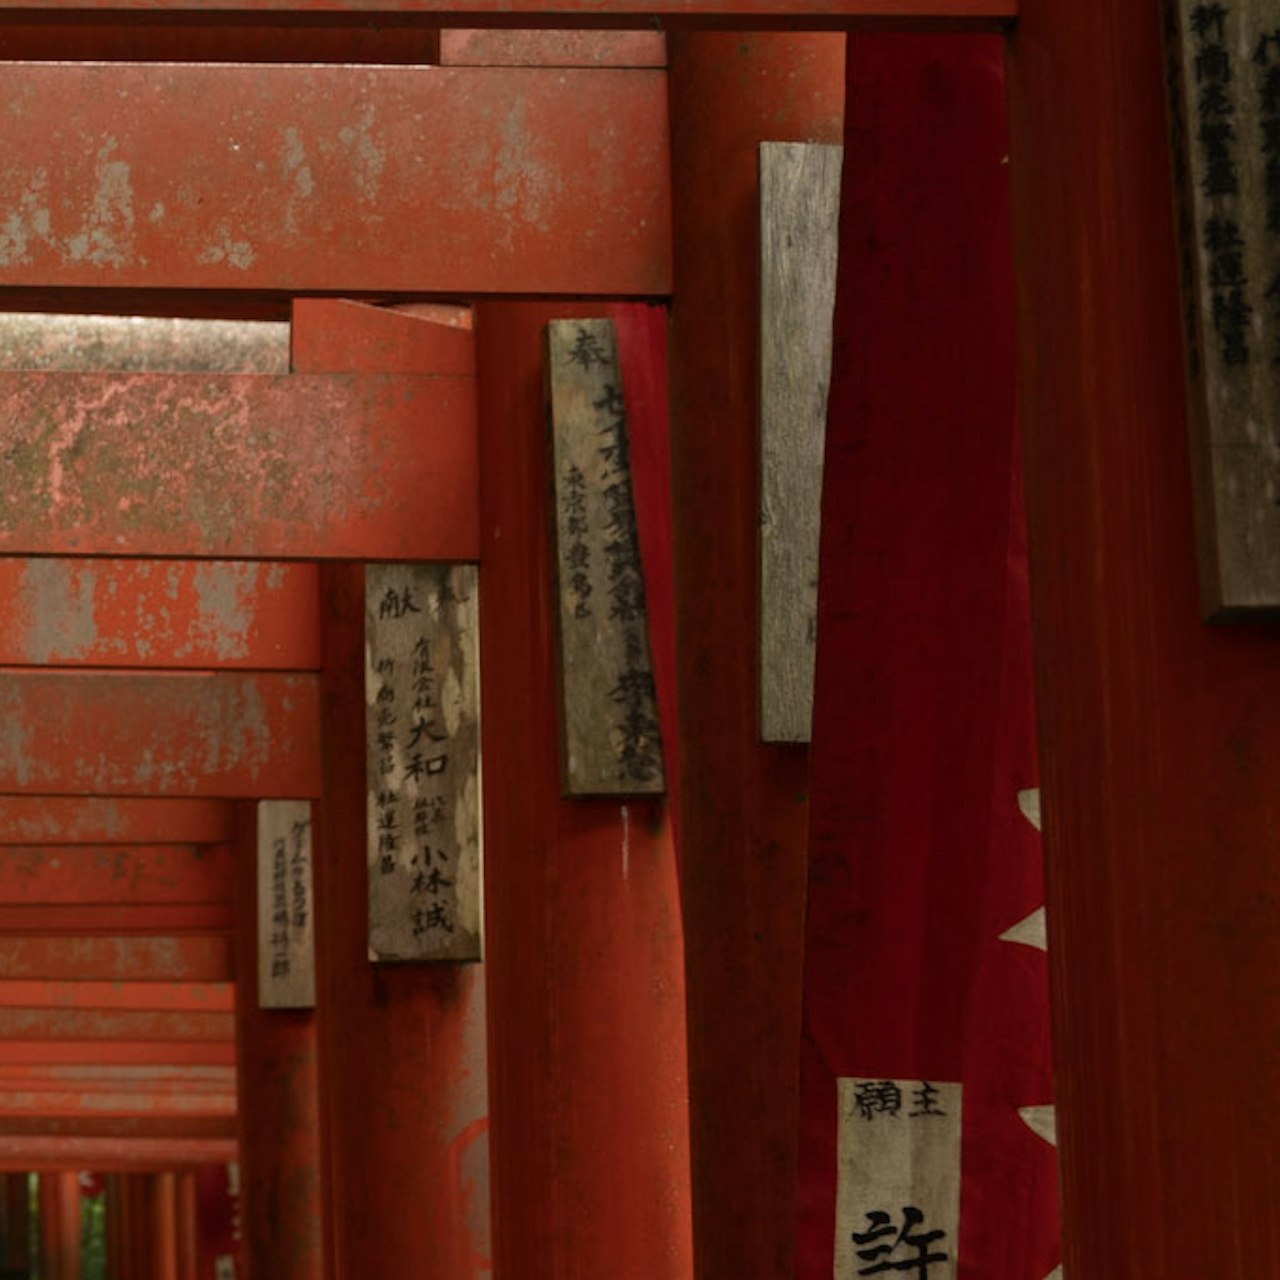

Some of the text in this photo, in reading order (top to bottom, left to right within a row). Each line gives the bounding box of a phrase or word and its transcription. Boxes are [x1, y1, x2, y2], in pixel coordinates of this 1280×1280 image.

[562, 328, 611, 371] 奉
[379, 586, 421, 620] 献
[850, 1081, 948, 1122] 願主
